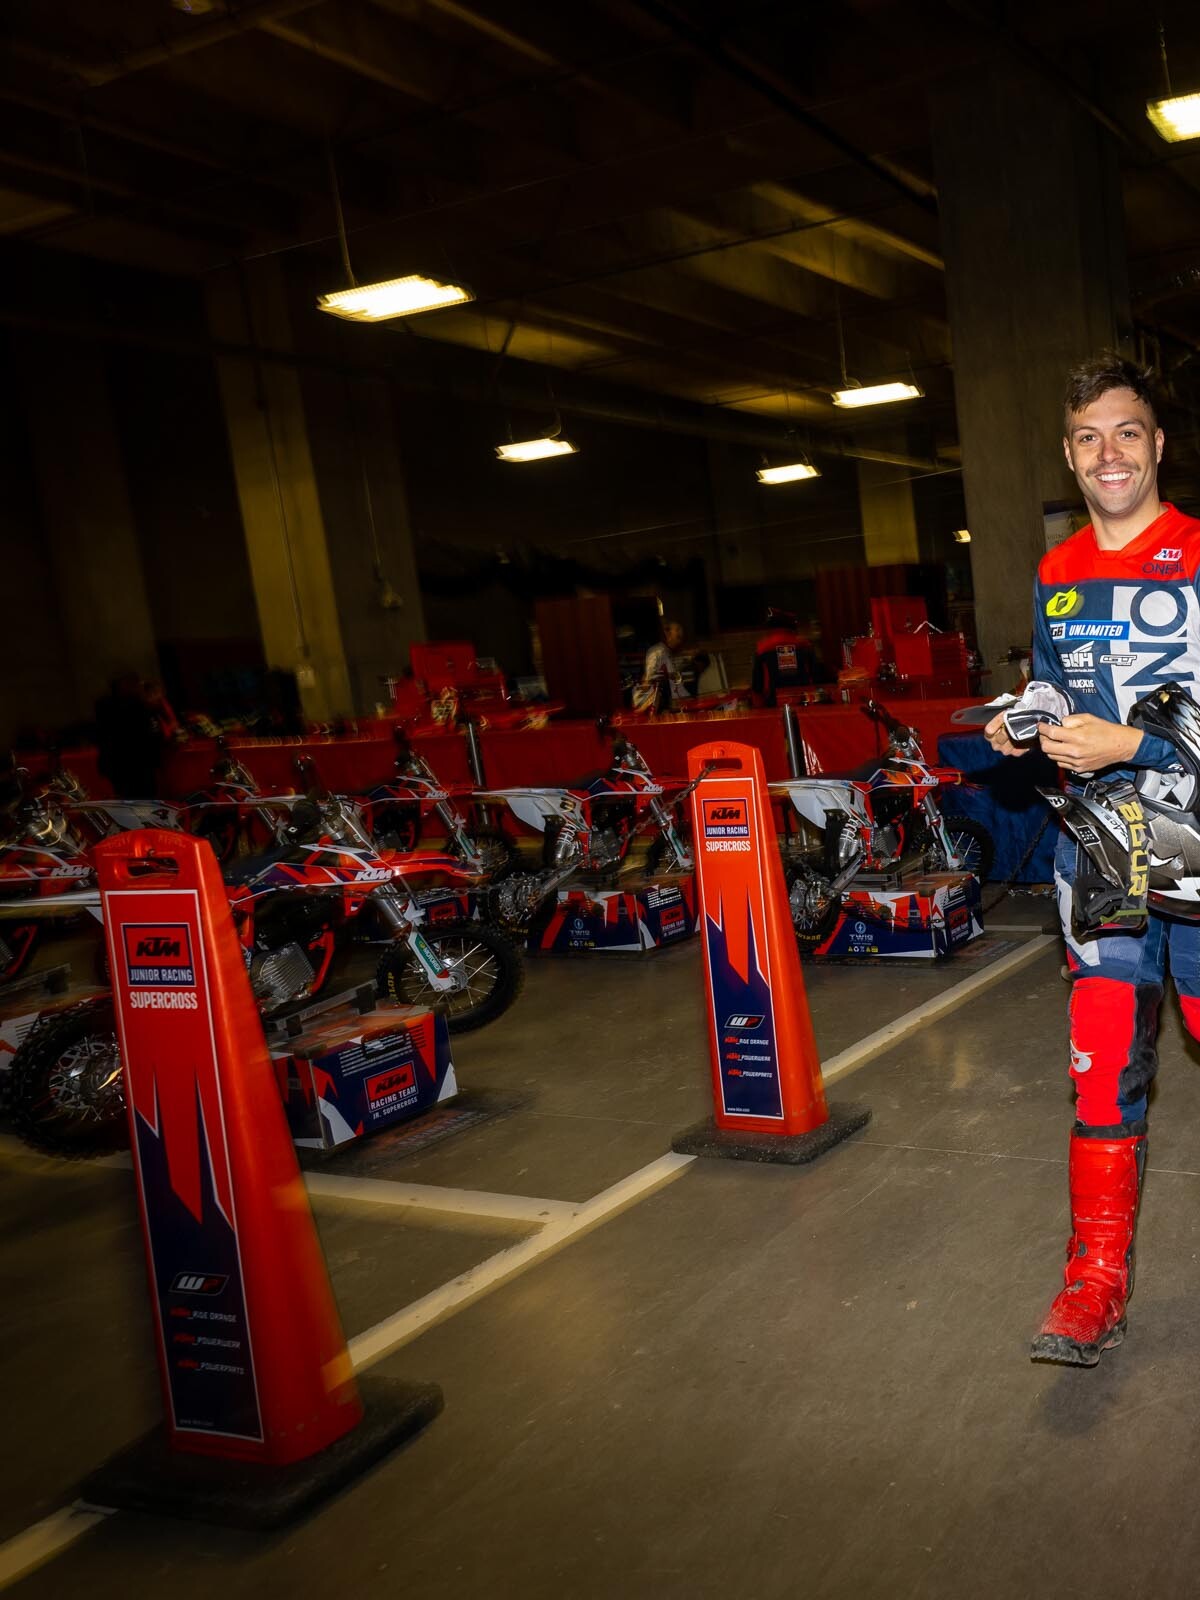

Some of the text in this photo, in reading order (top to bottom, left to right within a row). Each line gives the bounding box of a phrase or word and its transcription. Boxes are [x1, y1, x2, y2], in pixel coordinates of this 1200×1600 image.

[1068, 625, 1123, 637] UNLIMITED
[711, 807, 740, 820] KTM
[706, 826, 748, 835] JUNIOR RACING
[706, 840, 751, 852] SUPERCROSS
[1118, 801, 1149, 897] BLUR
[354, 868, 394, 881] KTM
[136, 937, 181, 957] KTM
[424, 946, 442, 972] MOTOREX
[131, 969, 193, 982] JUNIOR RACING
[130, 991, 198, 1009] SUPERCROSS
[375, 1073, 408, 1093] KTM
[370, 1085, 417, 1111] RACING TEAM
[383, 1096, 418, 1116] SUPERCROSS
